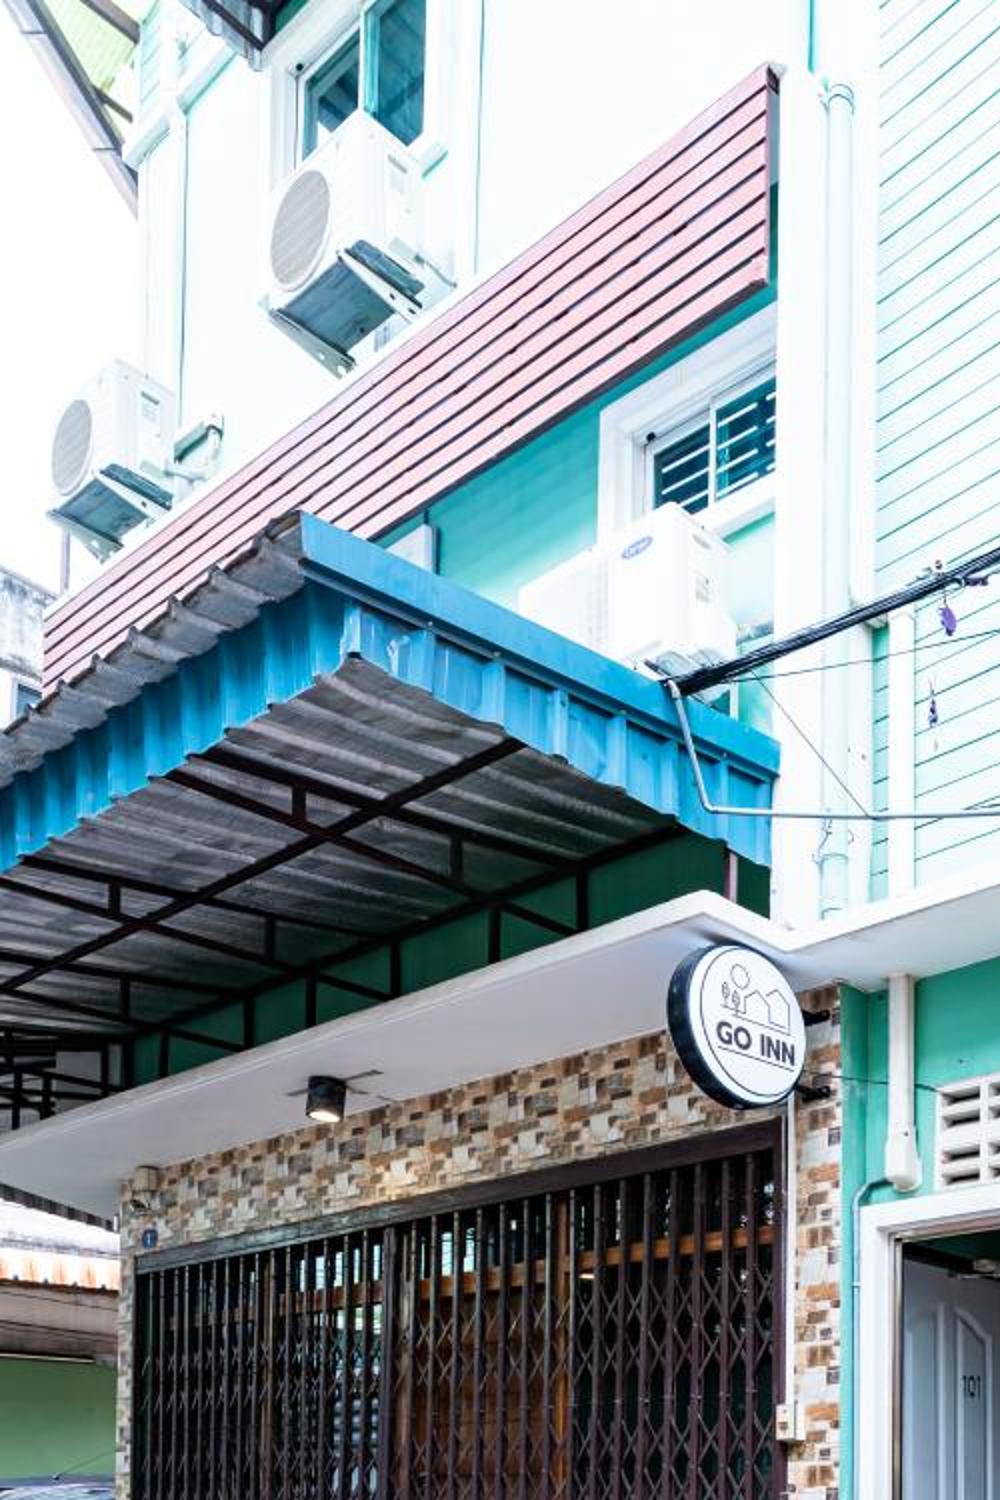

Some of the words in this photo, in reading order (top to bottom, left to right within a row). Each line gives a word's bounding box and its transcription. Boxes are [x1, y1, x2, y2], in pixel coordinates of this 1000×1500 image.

[717, 1021, 751, 1050] GO
[760, 1033, 796, 1067] INN
[962, 1375, 981, 1399] 101
